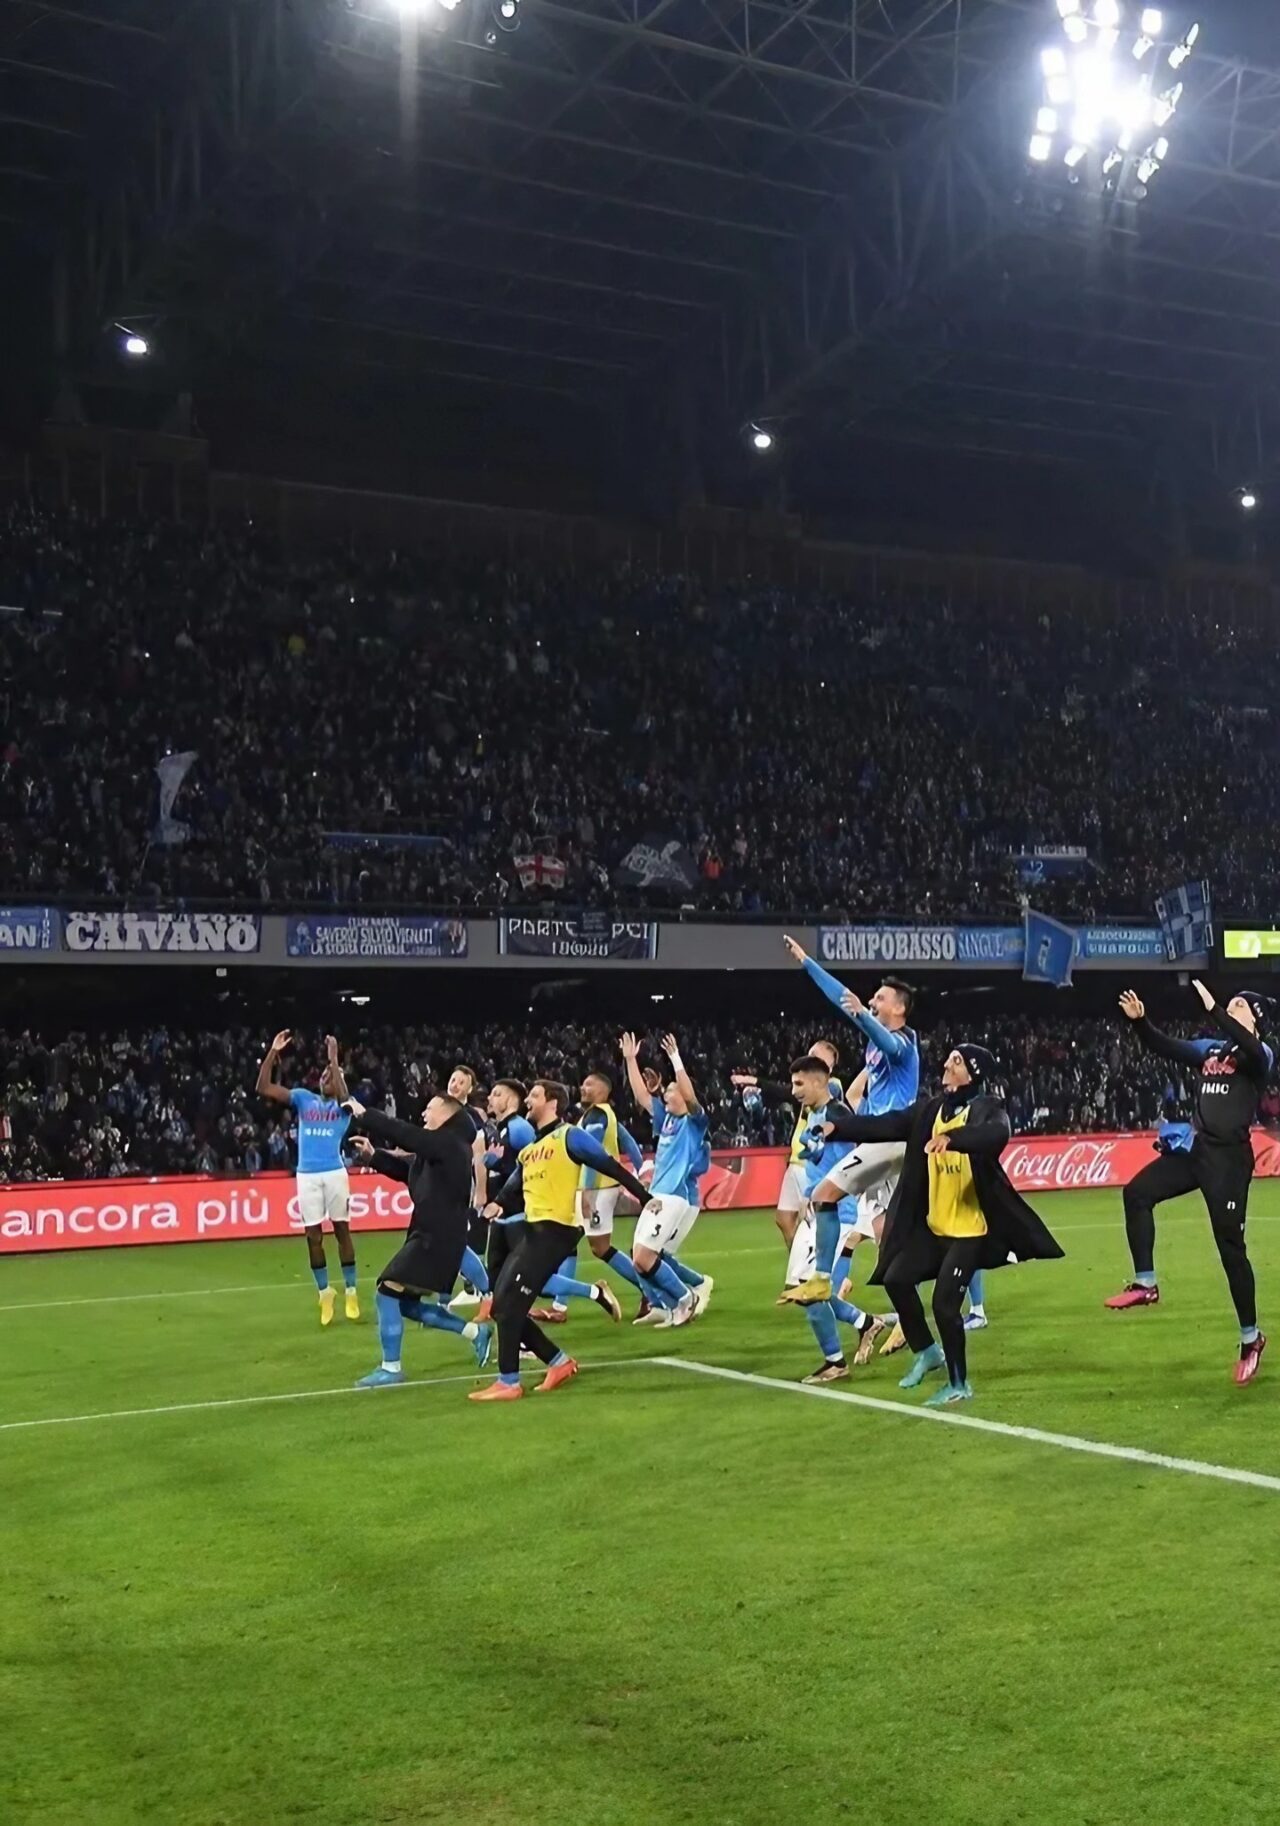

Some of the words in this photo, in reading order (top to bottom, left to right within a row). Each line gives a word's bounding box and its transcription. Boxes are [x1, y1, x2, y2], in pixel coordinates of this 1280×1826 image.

[66, 920, 257, 951] CAIVANO
[822, 933, 955, 960] CAMPOBASSO
[843, 1156, 862, 1170] 7
[1002, 1142, 1116, 1185] Coca-Cola
[1, 1202, 180, 1238] ancora
[197, 1188, 269, 1233] più
[286, 1184, 415, 1228] gsto
